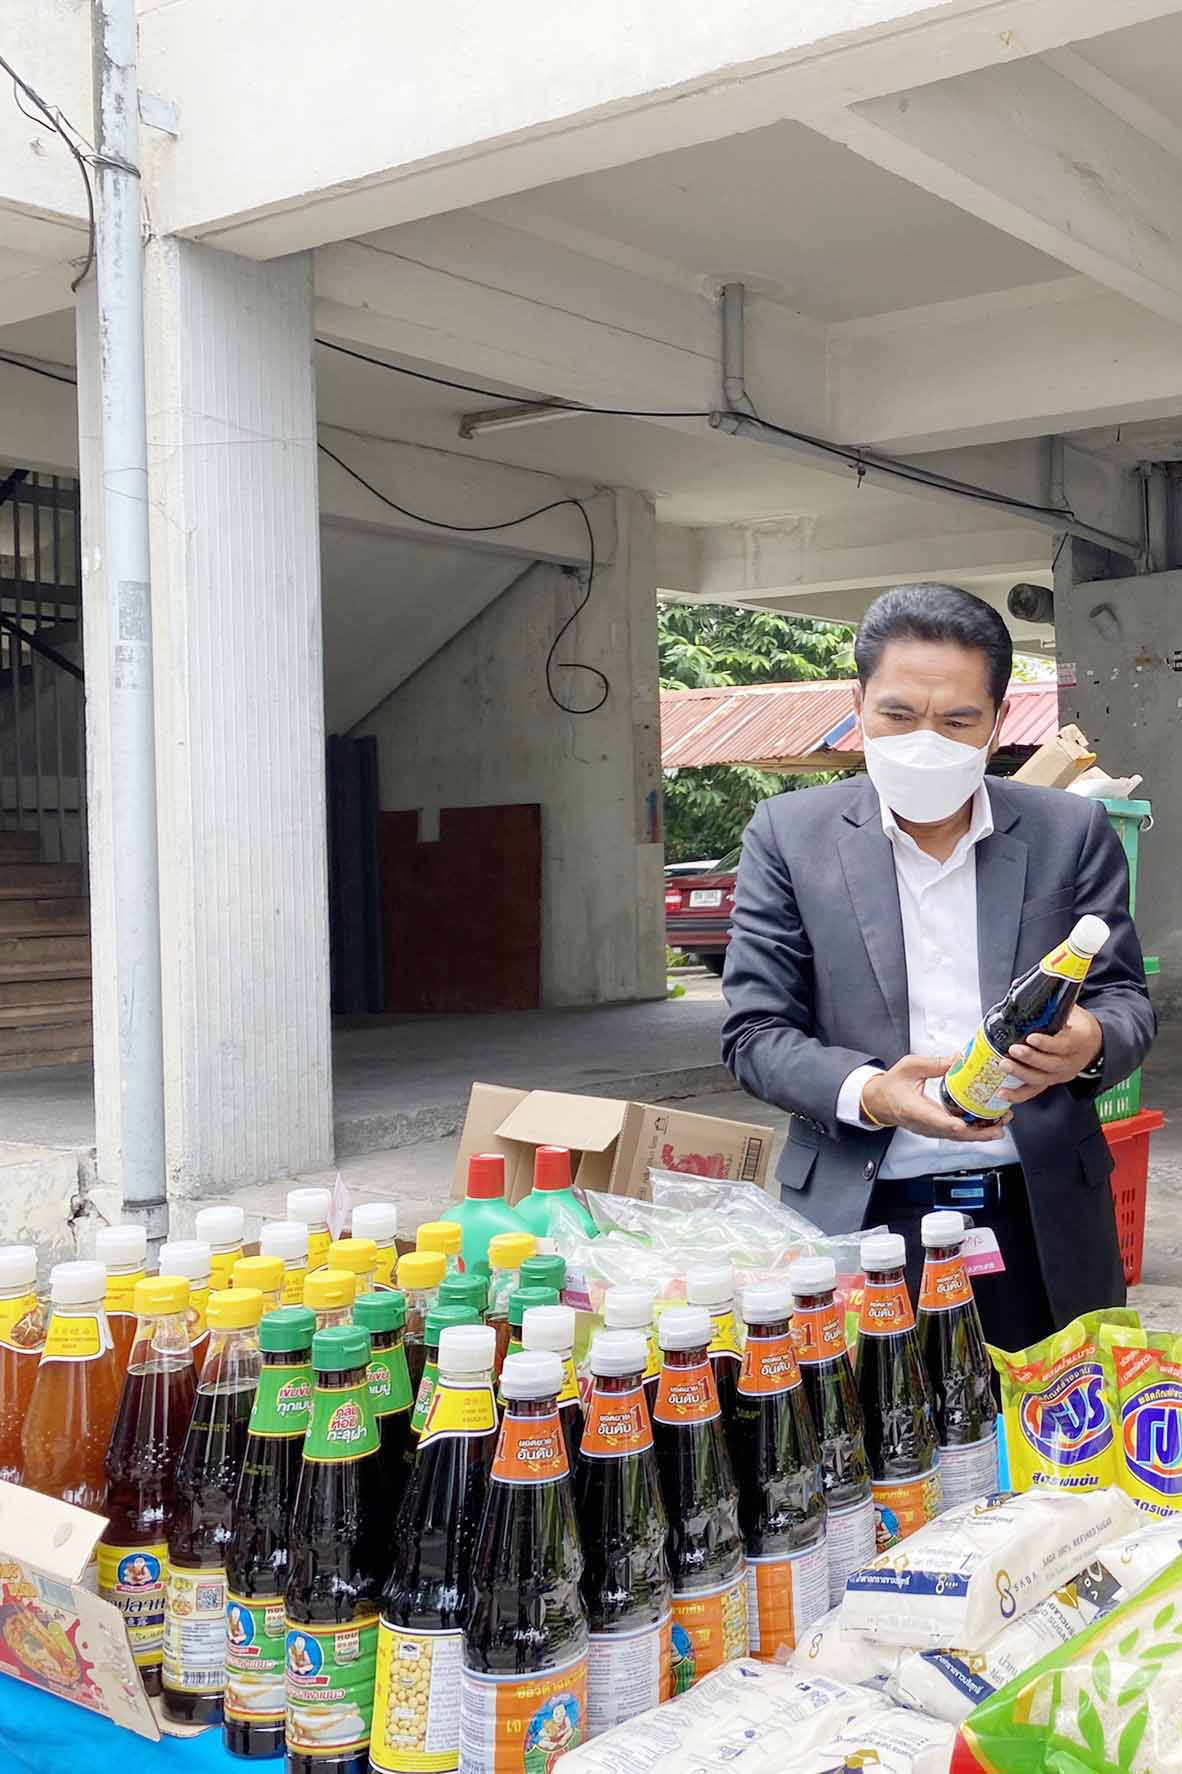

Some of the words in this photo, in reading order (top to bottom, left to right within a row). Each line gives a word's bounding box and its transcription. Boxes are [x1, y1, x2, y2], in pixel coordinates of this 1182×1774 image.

[760, 1362, 791, 1376] อันดับ
[668, 1393, 700, 1405] อันดับ
[598, 1422, 632, 1435] อันดับ
[517, 1447, 553, 1460] อันดับ
[1032, 1471, 1099, 1487] สูตรเข้มข้น
